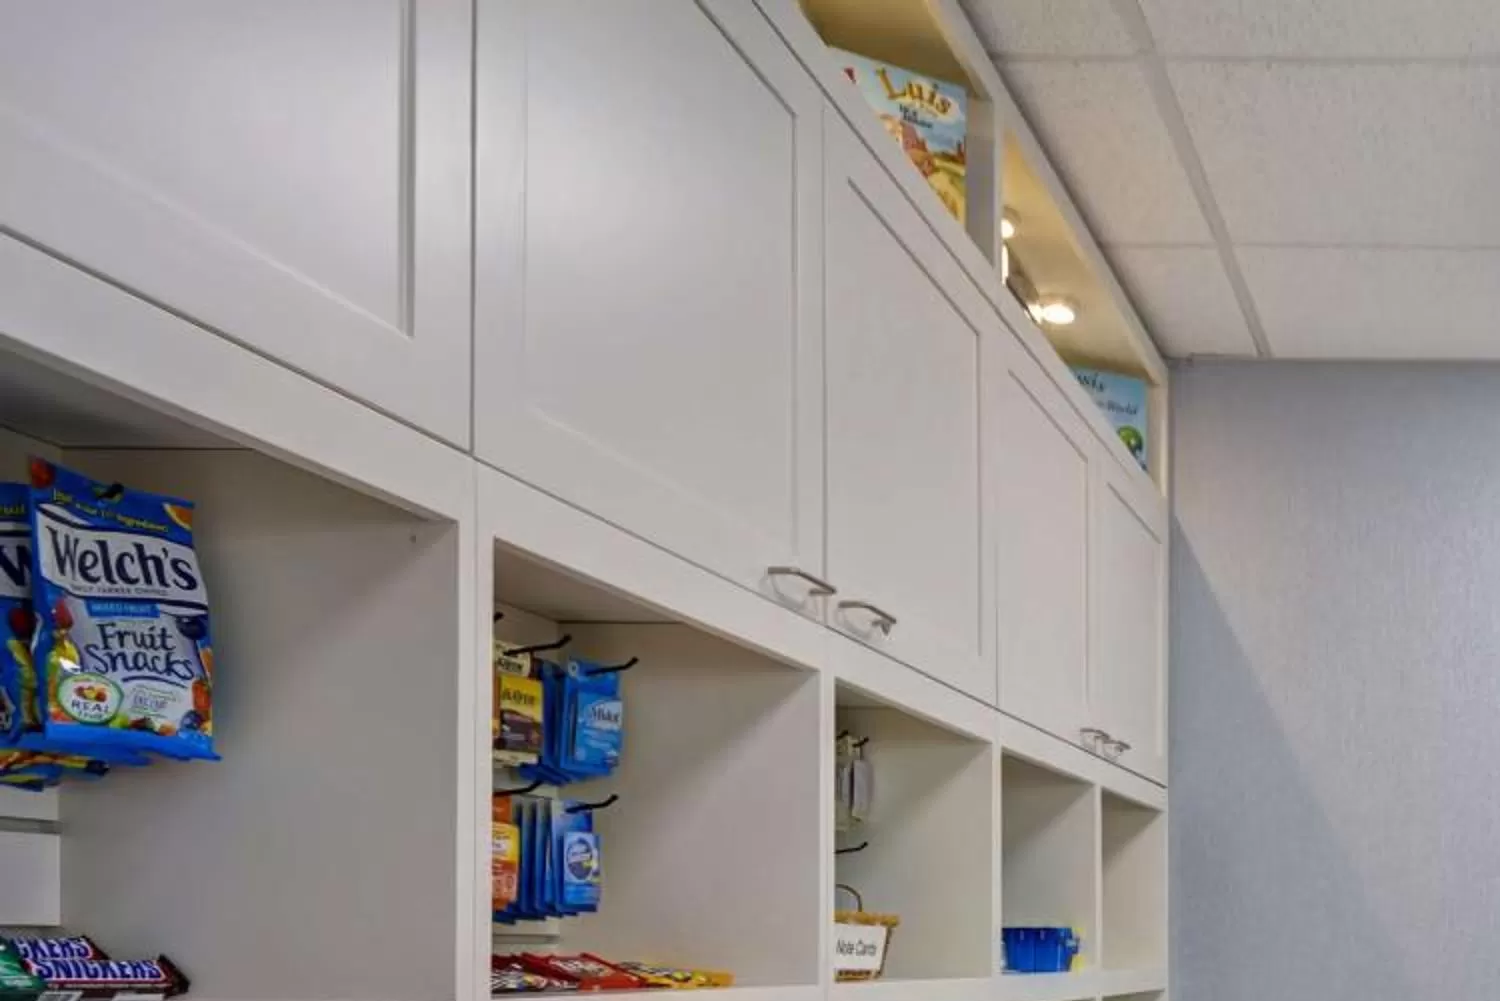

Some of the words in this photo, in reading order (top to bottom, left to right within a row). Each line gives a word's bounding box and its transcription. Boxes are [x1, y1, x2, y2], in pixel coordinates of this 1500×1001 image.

[46, 525, 198, 591] Welch's
[97, 622, 176, 651] Fruit
[84, 643, 195, 681] Snacks
[16, 936, 93, 960] CKERS
[37, 959, 165, 980] SNICKERS
